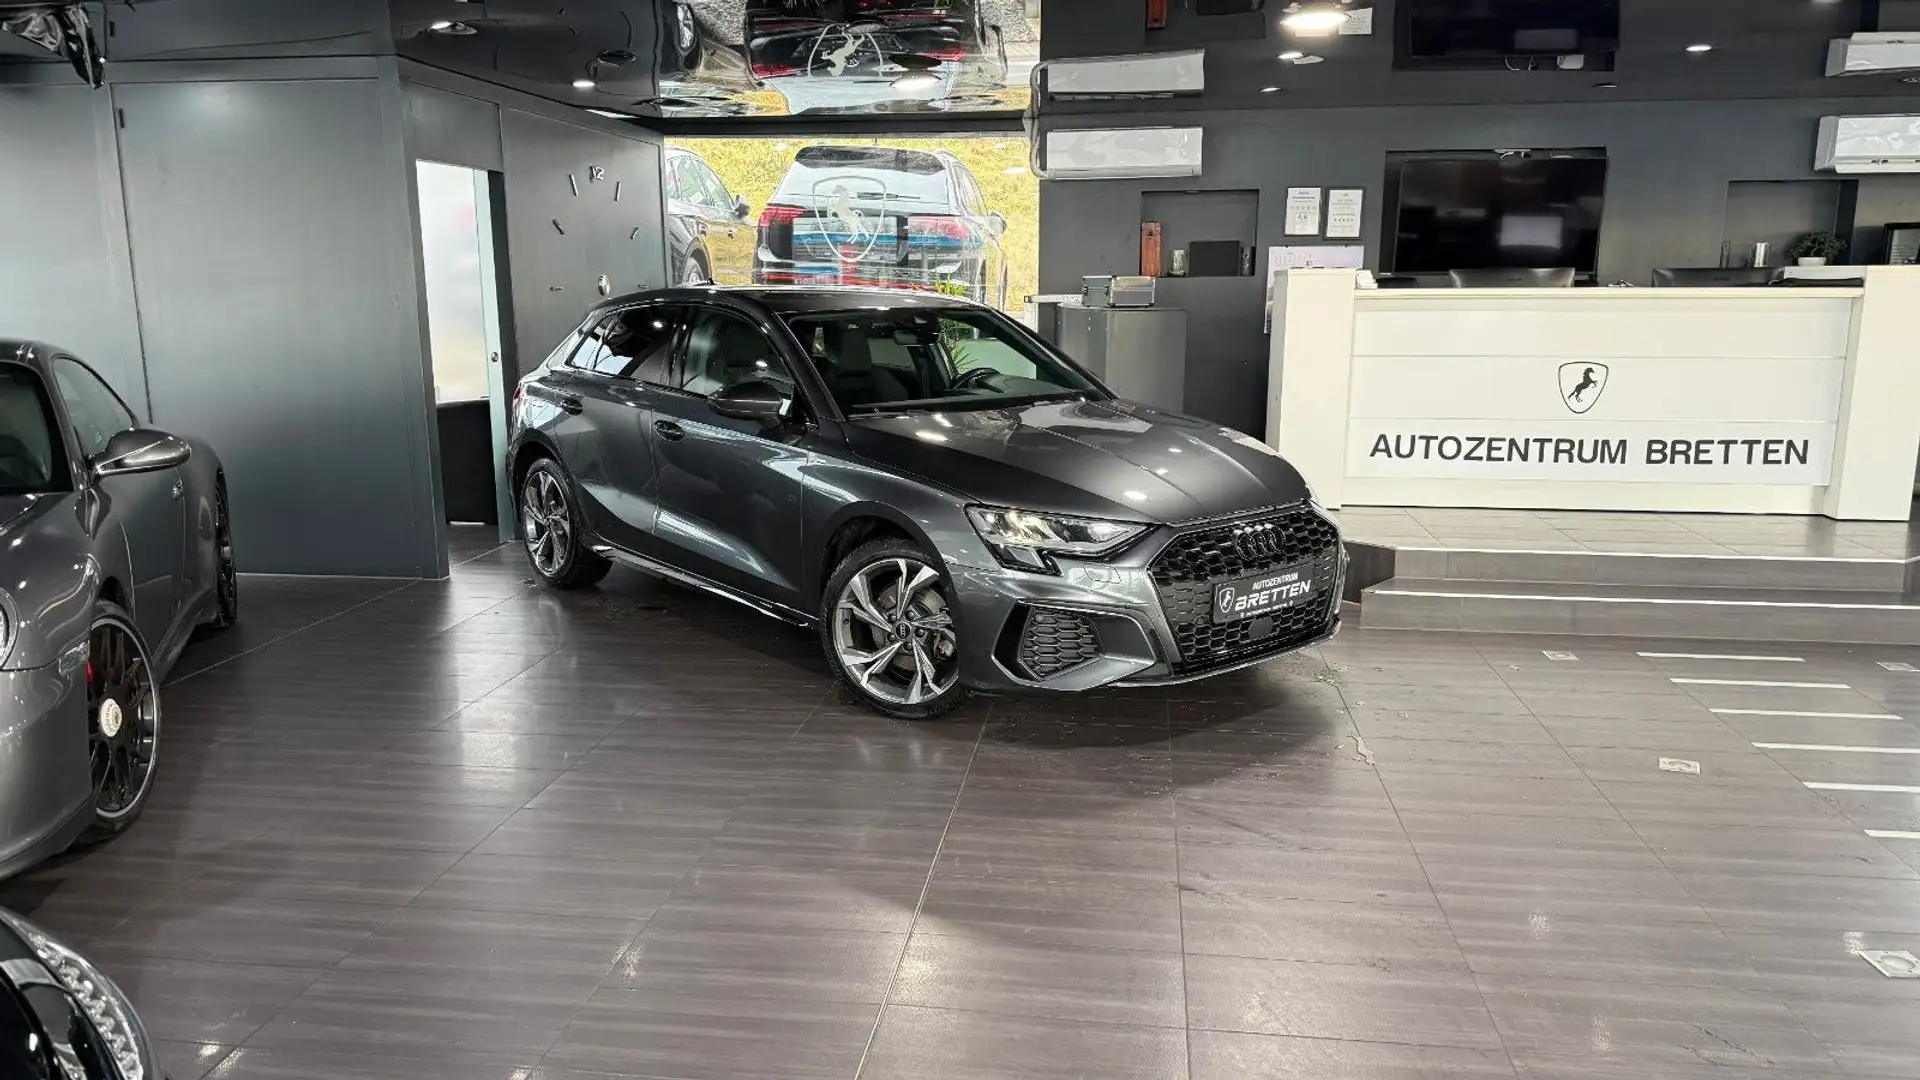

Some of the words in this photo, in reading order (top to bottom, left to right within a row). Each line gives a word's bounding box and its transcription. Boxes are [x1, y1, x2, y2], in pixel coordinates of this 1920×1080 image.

[590, 165, 604, 181] 12
[1369, 433, 1627, 465] AUTOZENTRUM
[1645, 439, 1809, 465] BRETTEN
[1252, 572, 1299, 590] AUTOZENTRUM
[1235, 580, 1311, 611] BRETTEN
